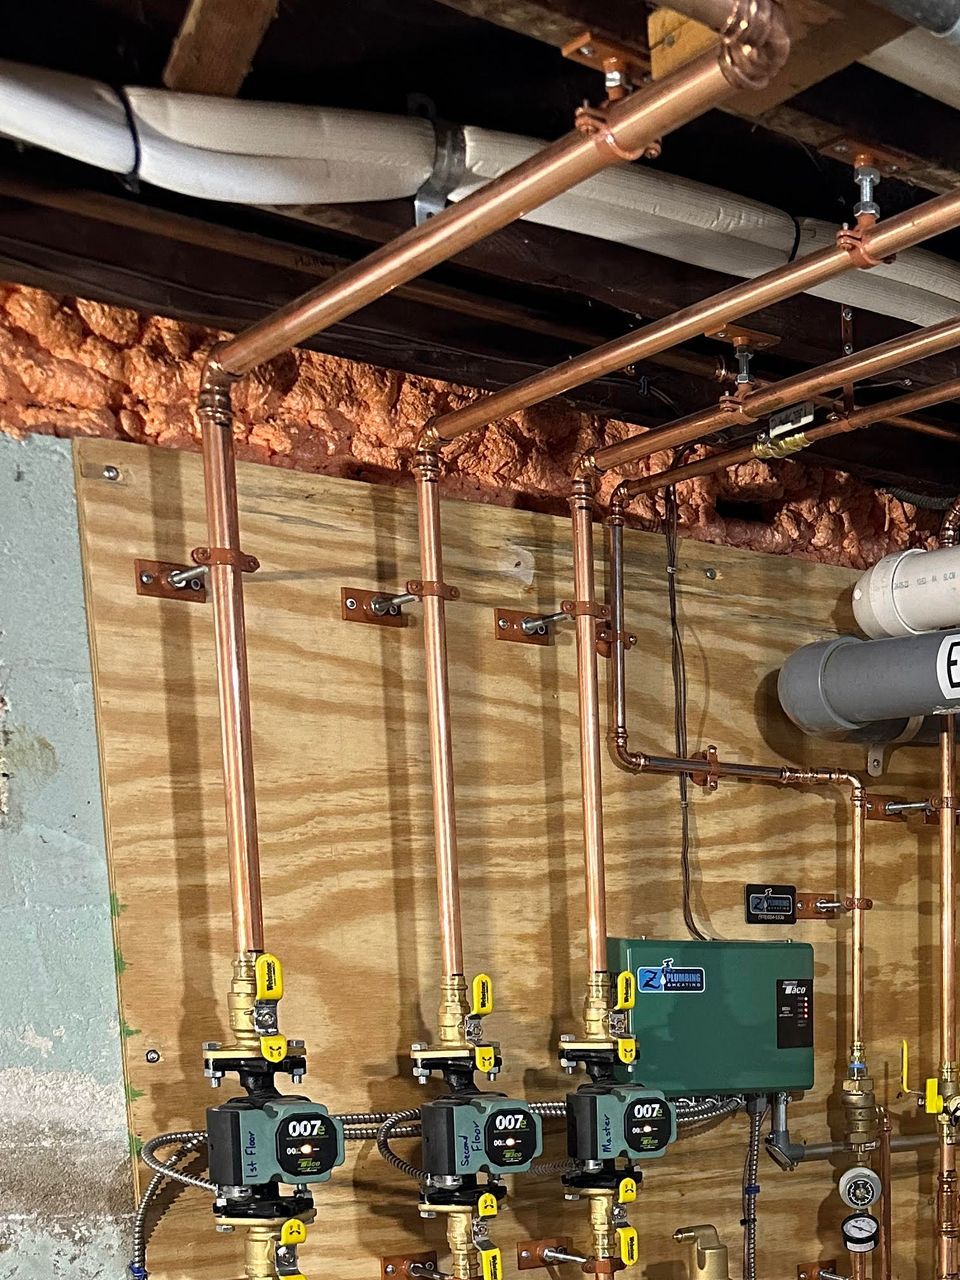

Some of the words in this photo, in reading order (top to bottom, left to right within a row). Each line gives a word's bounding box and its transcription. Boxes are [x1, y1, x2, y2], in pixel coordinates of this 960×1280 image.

[643, 970, 660, 989] Z
[667, 973, 701, 982] PLUMBING
[782, 981, 806, 994] Taco
[245, 1131, 257, 1156] Floor
[471, 1121, 483, 1152] Floor
[602, 1114, 612, 1153] Master
[458, 1135, 471, 1167] Second
[245, 1162, 258, 1178] 1st
